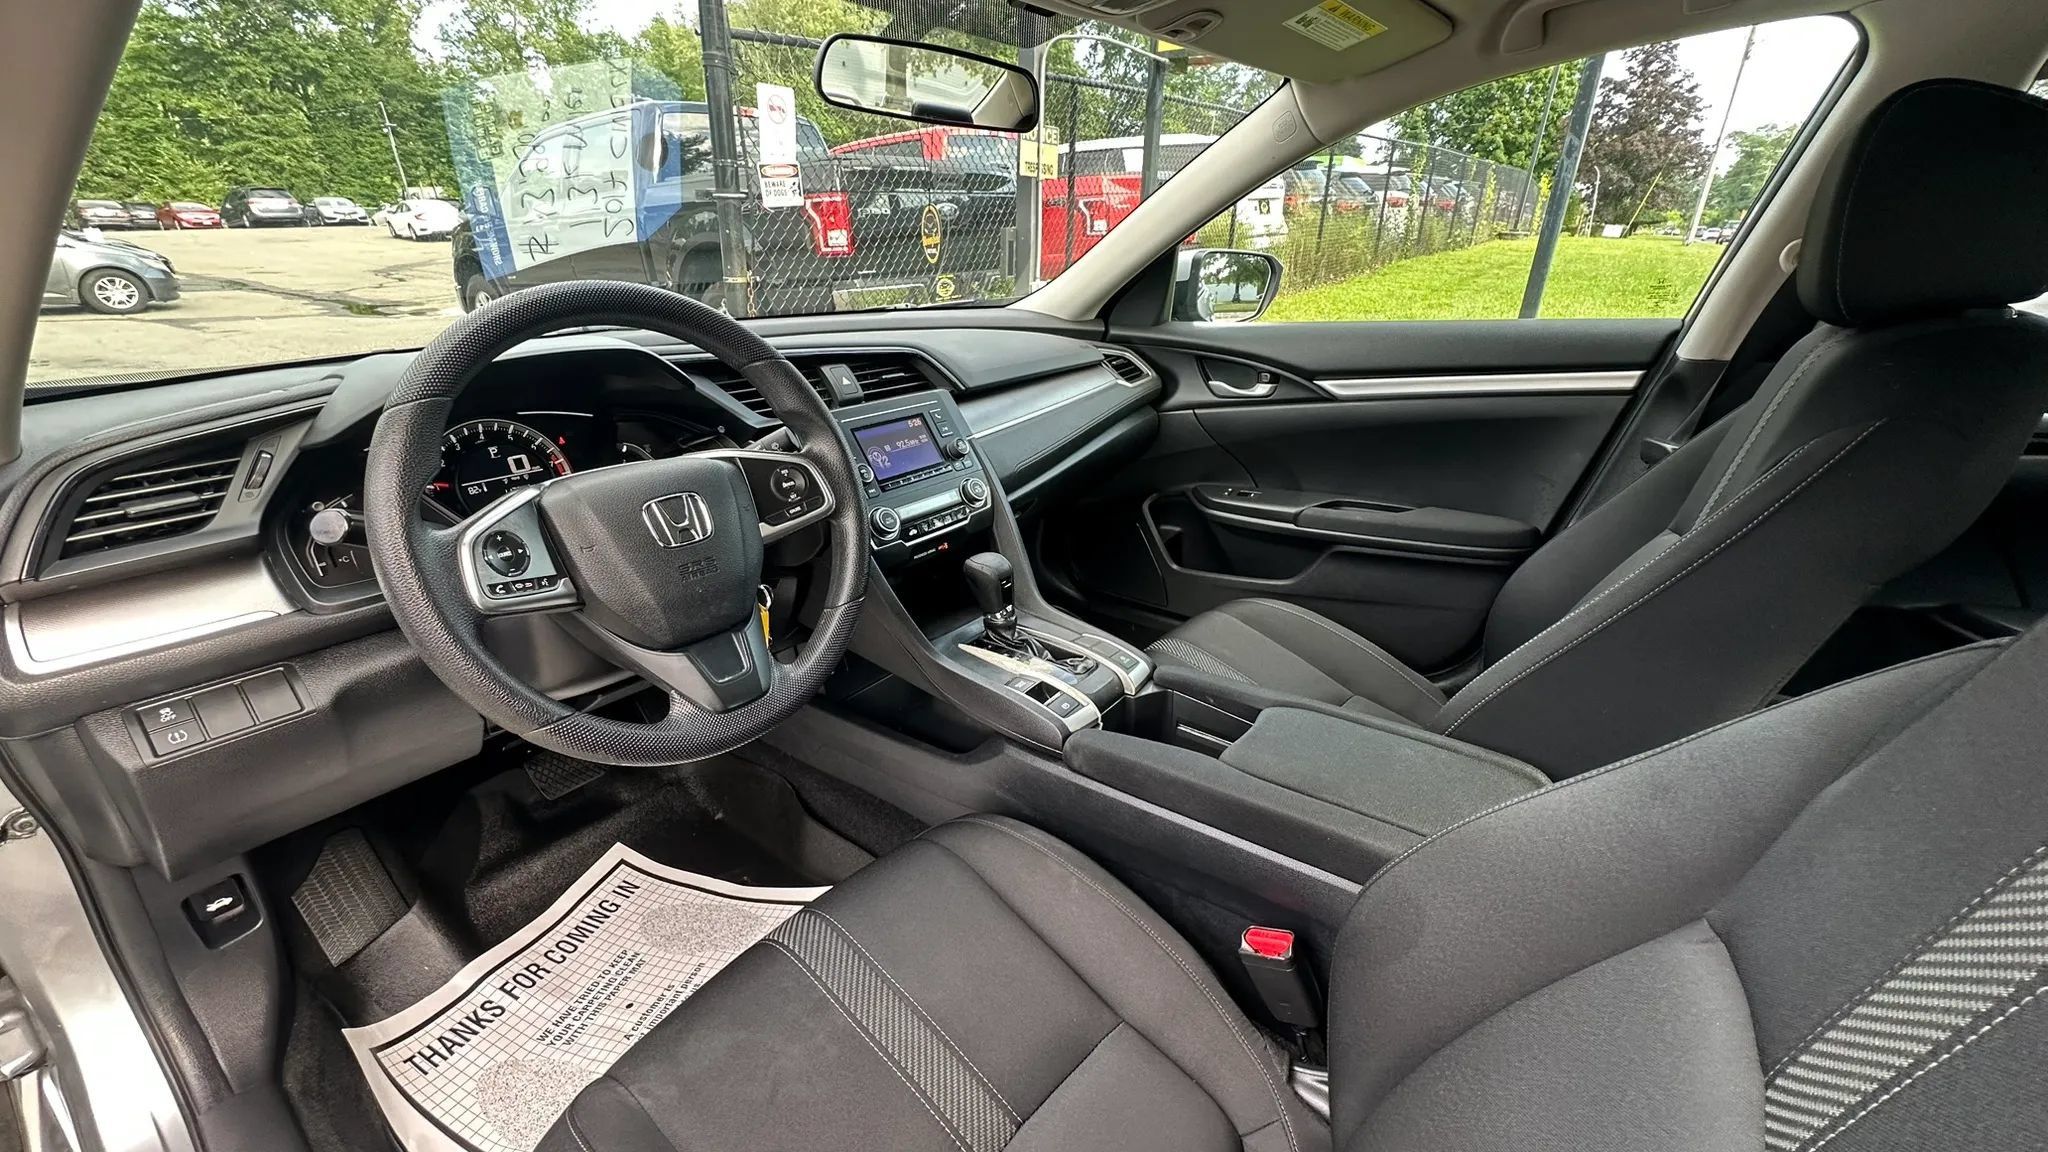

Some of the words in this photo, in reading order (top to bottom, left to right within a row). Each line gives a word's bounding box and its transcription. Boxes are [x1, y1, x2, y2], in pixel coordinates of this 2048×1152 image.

[160, 714, 176, 723] OFF
[402, 999, 507, 1076] THANKS
[499, 962, 551, 1001] FOR
[543, 899, 622, 965] COMING
[612, 879, 641, 899] IN
[536, 1027, 556, 1042] WE
[552, 1005, 578, 1028] HAVE
[573, 980, 600, 1005] TRIED
[597, 969, 611, 980] TO
[609, 949, 629, 969] KEEP
[547, 1022, 575, 1047] YOUR
[572, 977, 618, 1022] CARPETING
[615, 951, 641, 976] CLEAN
[562, 1022, 589, 1047] WITH
[585, 1002, 607, 1023] THIS
[604, 975, 631, 1001] PAPER
[629, 958, 646, 975] MAT
[623, 1033, 635, 1041] A
[631, 993, 667, 1032] customer
[645, 990, 682, 1030] important
[681, 962, 706, 990] person
